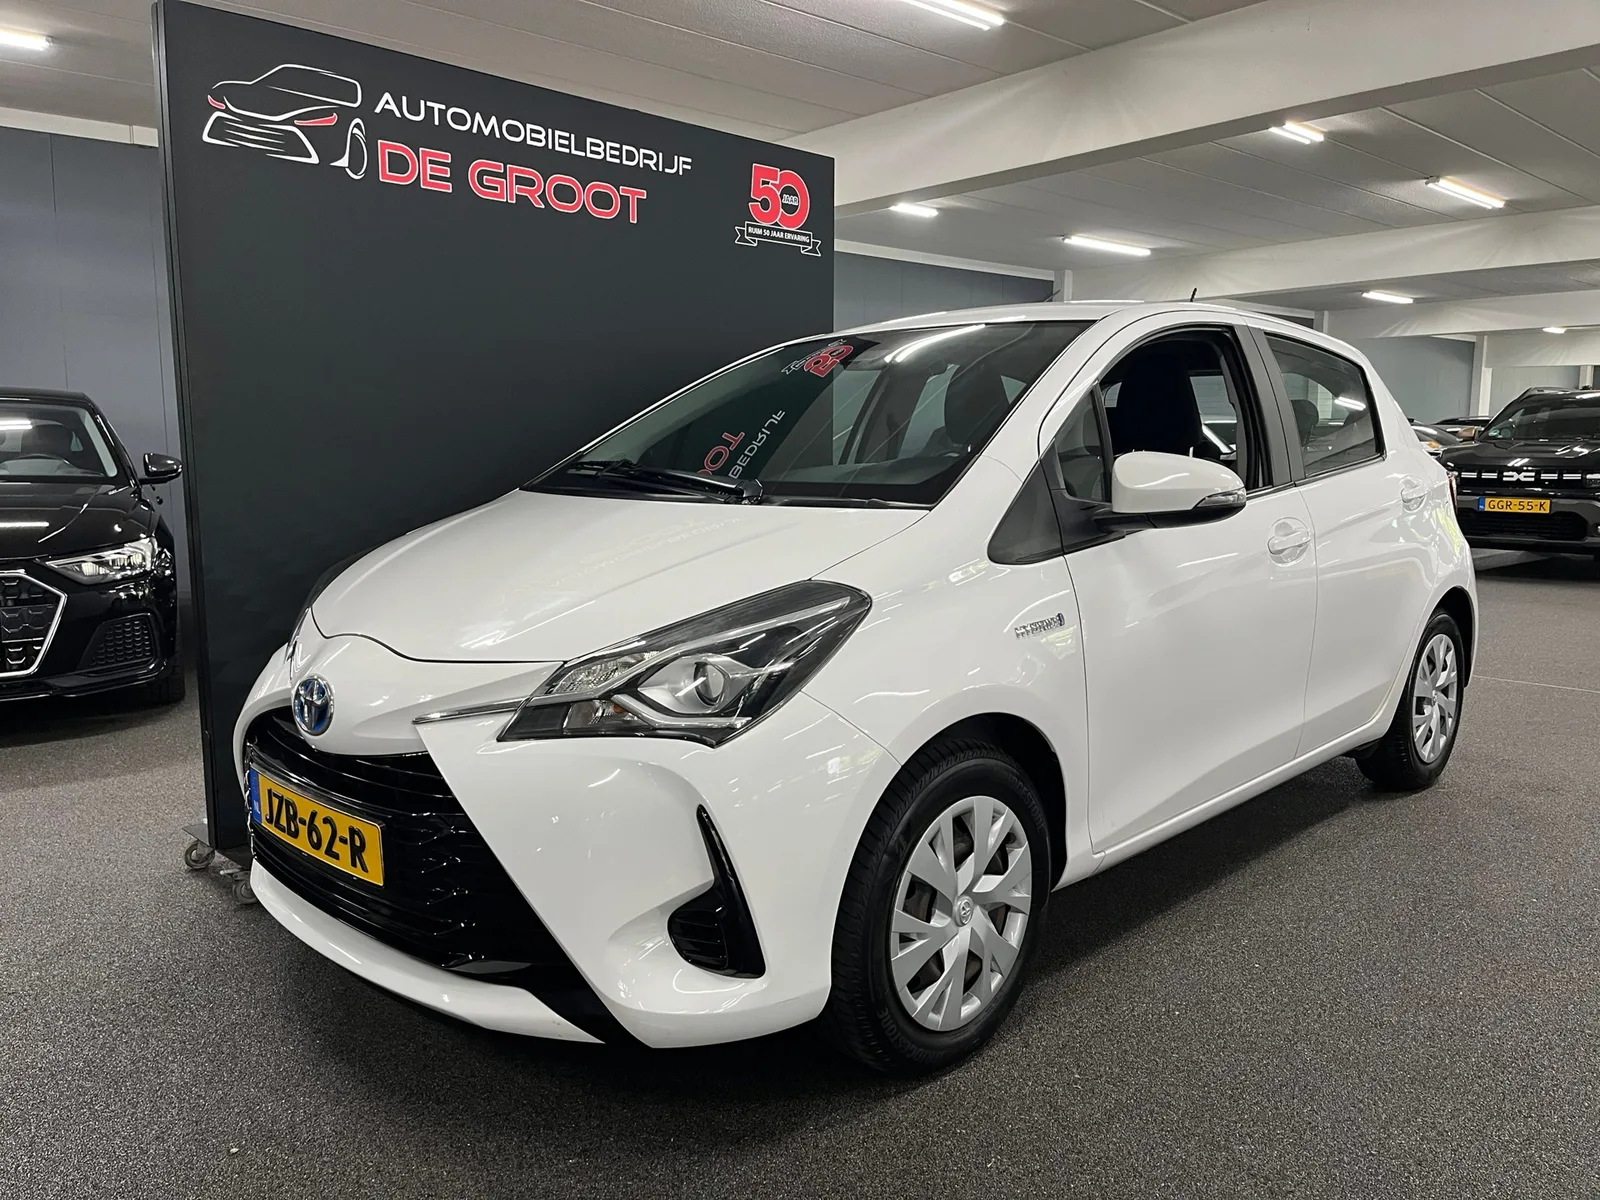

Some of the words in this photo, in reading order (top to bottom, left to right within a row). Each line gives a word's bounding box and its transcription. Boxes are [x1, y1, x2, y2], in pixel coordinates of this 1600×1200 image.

[374, 92, 693, 176] AUTOMOBIELBEDRIJF
[378, 140, 452, 193] DE
[468, 158, 647, 224] GROOT
[748, 163, 810, 230] 50
[782, 194, 799, 206] JAAR
[749, 226, 763, 235] RUIM
[764, 229, 770, 237] 50
[771, 230, 784, 239] JAAR
[784, 233, 810, 243] ERVARING
[1488, 499, 1546, 511] GGR-55-K
[265, 788, 369, 874] JZB-62-R
